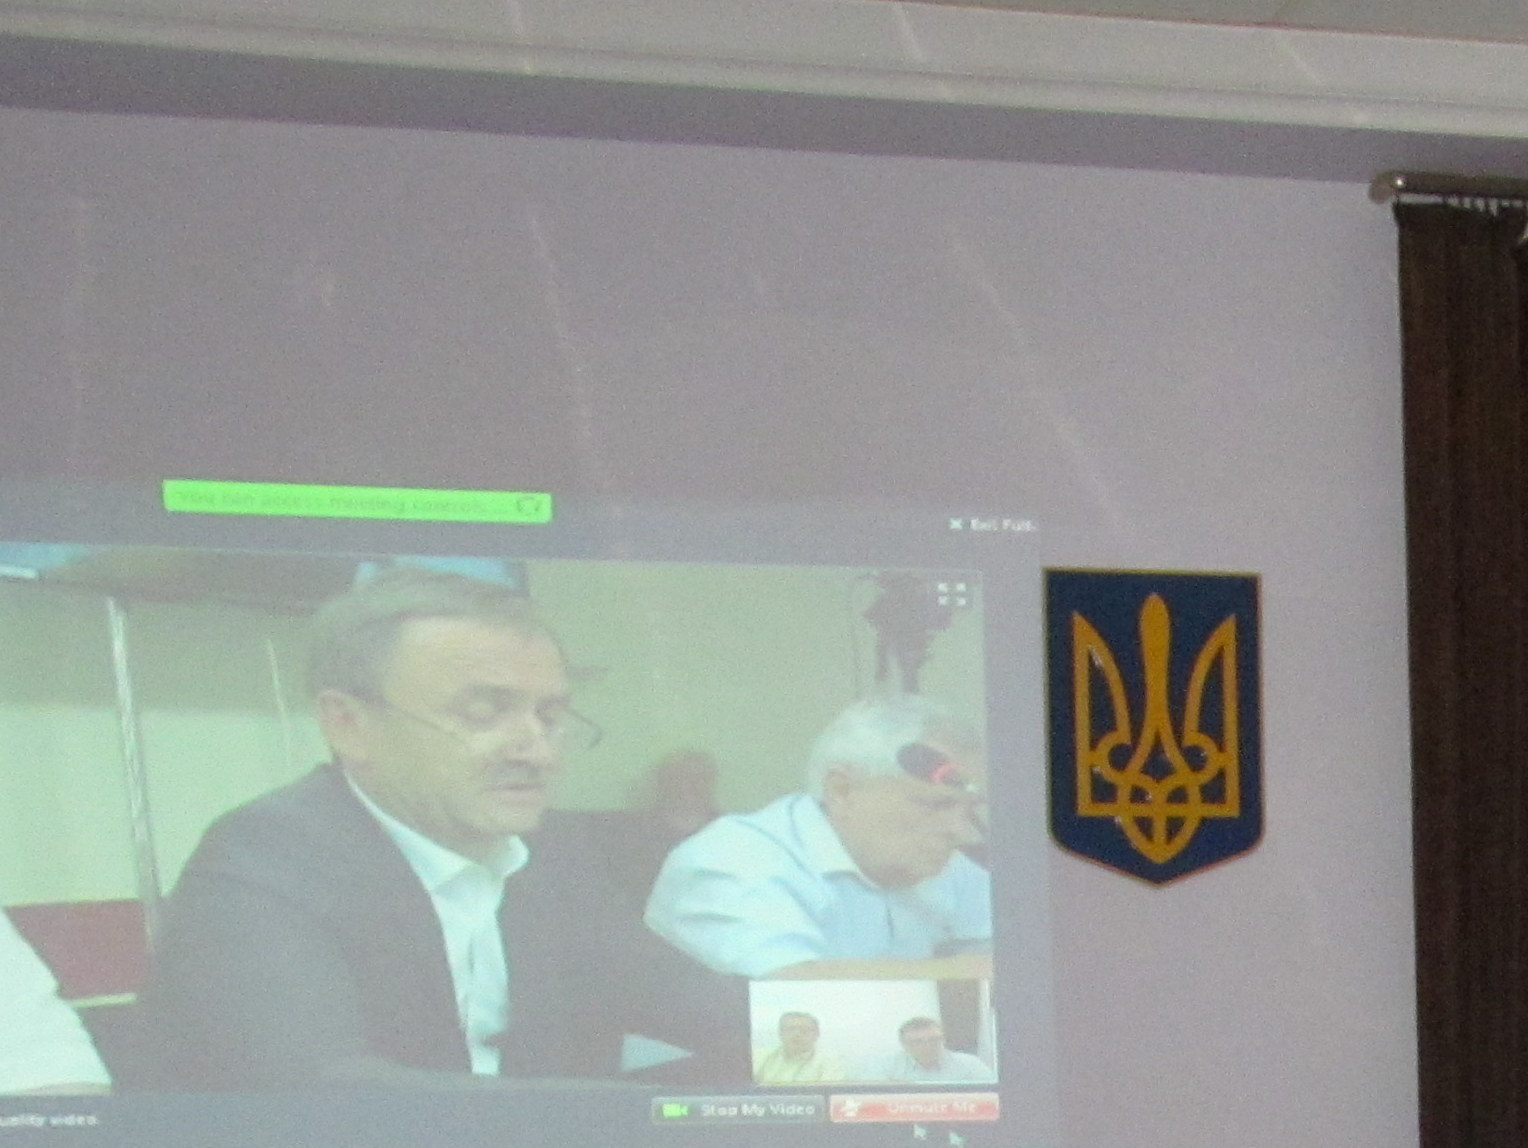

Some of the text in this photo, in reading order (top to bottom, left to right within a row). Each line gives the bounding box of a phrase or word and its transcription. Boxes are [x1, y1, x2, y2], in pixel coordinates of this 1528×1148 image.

[702, 1102, 815, 1119] Stop My Video
